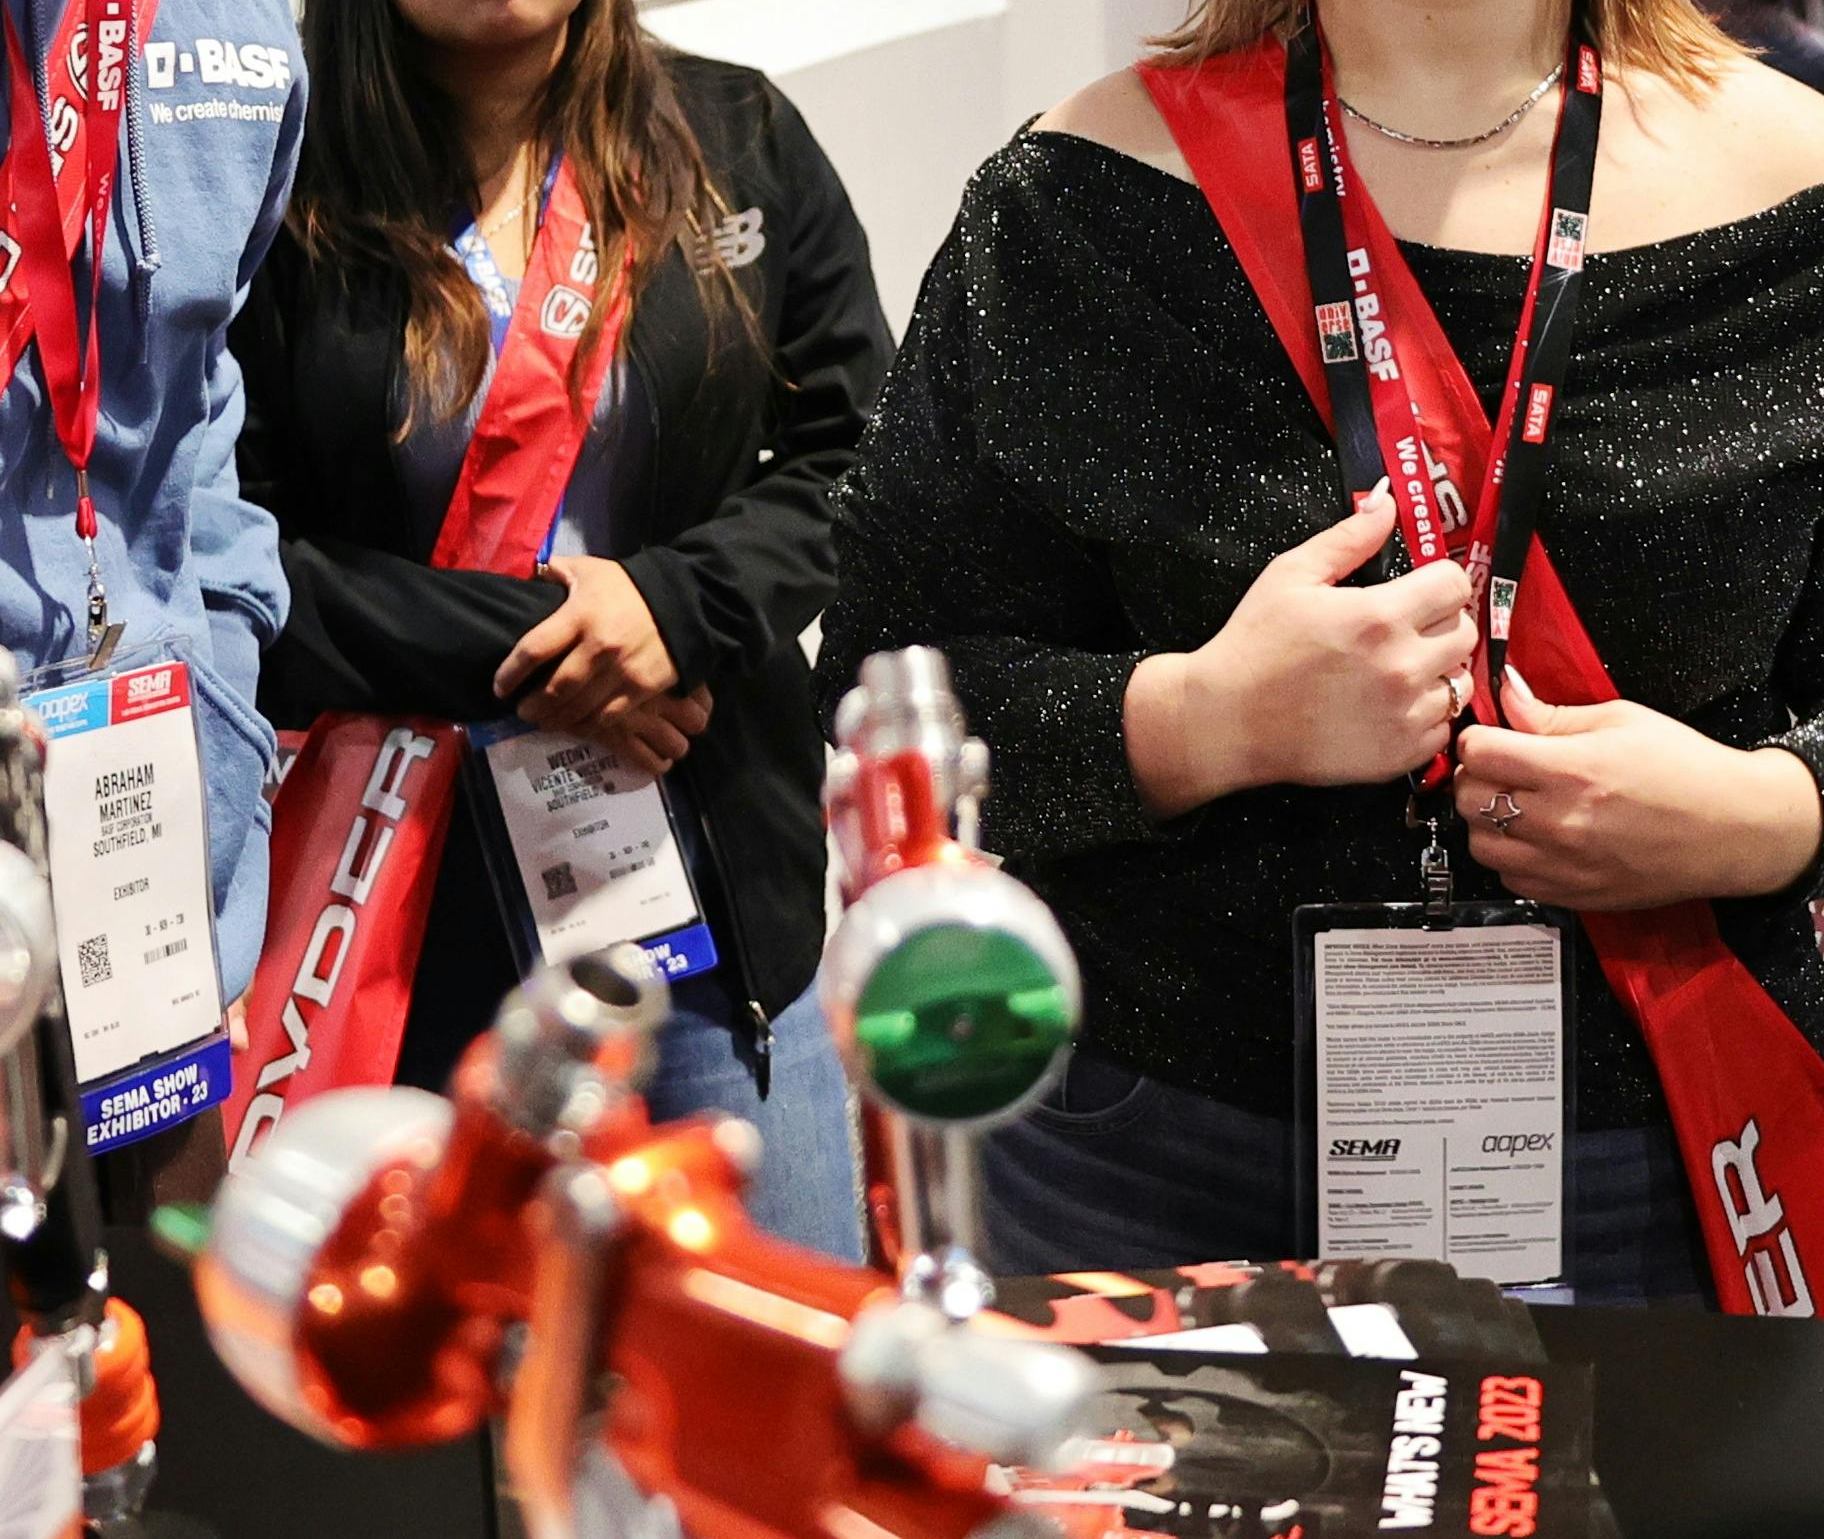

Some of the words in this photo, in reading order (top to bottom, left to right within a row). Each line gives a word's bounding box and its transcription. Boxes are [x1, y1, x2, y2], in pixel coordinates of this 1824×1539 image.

[96, 18, 127, 111] BASF
[195, 38, 292, 90] BASF
[150, 102, 174, 126] We
[176, 98, 227, 123] create
[1301, 142, 1320, 188] SATA
[1354, 292, 1400, 383] BASF
[1527, 388, 1548, 438] SATA
[1395, 435, 1417, 476] We
[1407, 479, 1437, 557] create
[128, 669, 172, 698] SEMA
[95, 762, 155, 801] ABRAHAM
[99, 790, 153, 823] MARTINEZ
[151, 821, 162, 839] MI
[113, 876, 150, 901] EXHIBITOR
[665, 953, 689, 975] 23
[86, 1093, 181, 1146] EXHIBITOR
[191, 1080, 209, 1105] 23
[100, 1084, 151, 1120] SEMA
[152, 1062, 198, 1101] SHOW
[1328, 1137, 1402, 1156] SEMA
[1481, 1132, 1556, 1158] aapex
[1393, 1369, 1449, 1434] NEW
[1477, 1375, 1544, 1442] 2023
[1469, 1445, 1541, 1538] SEMA
